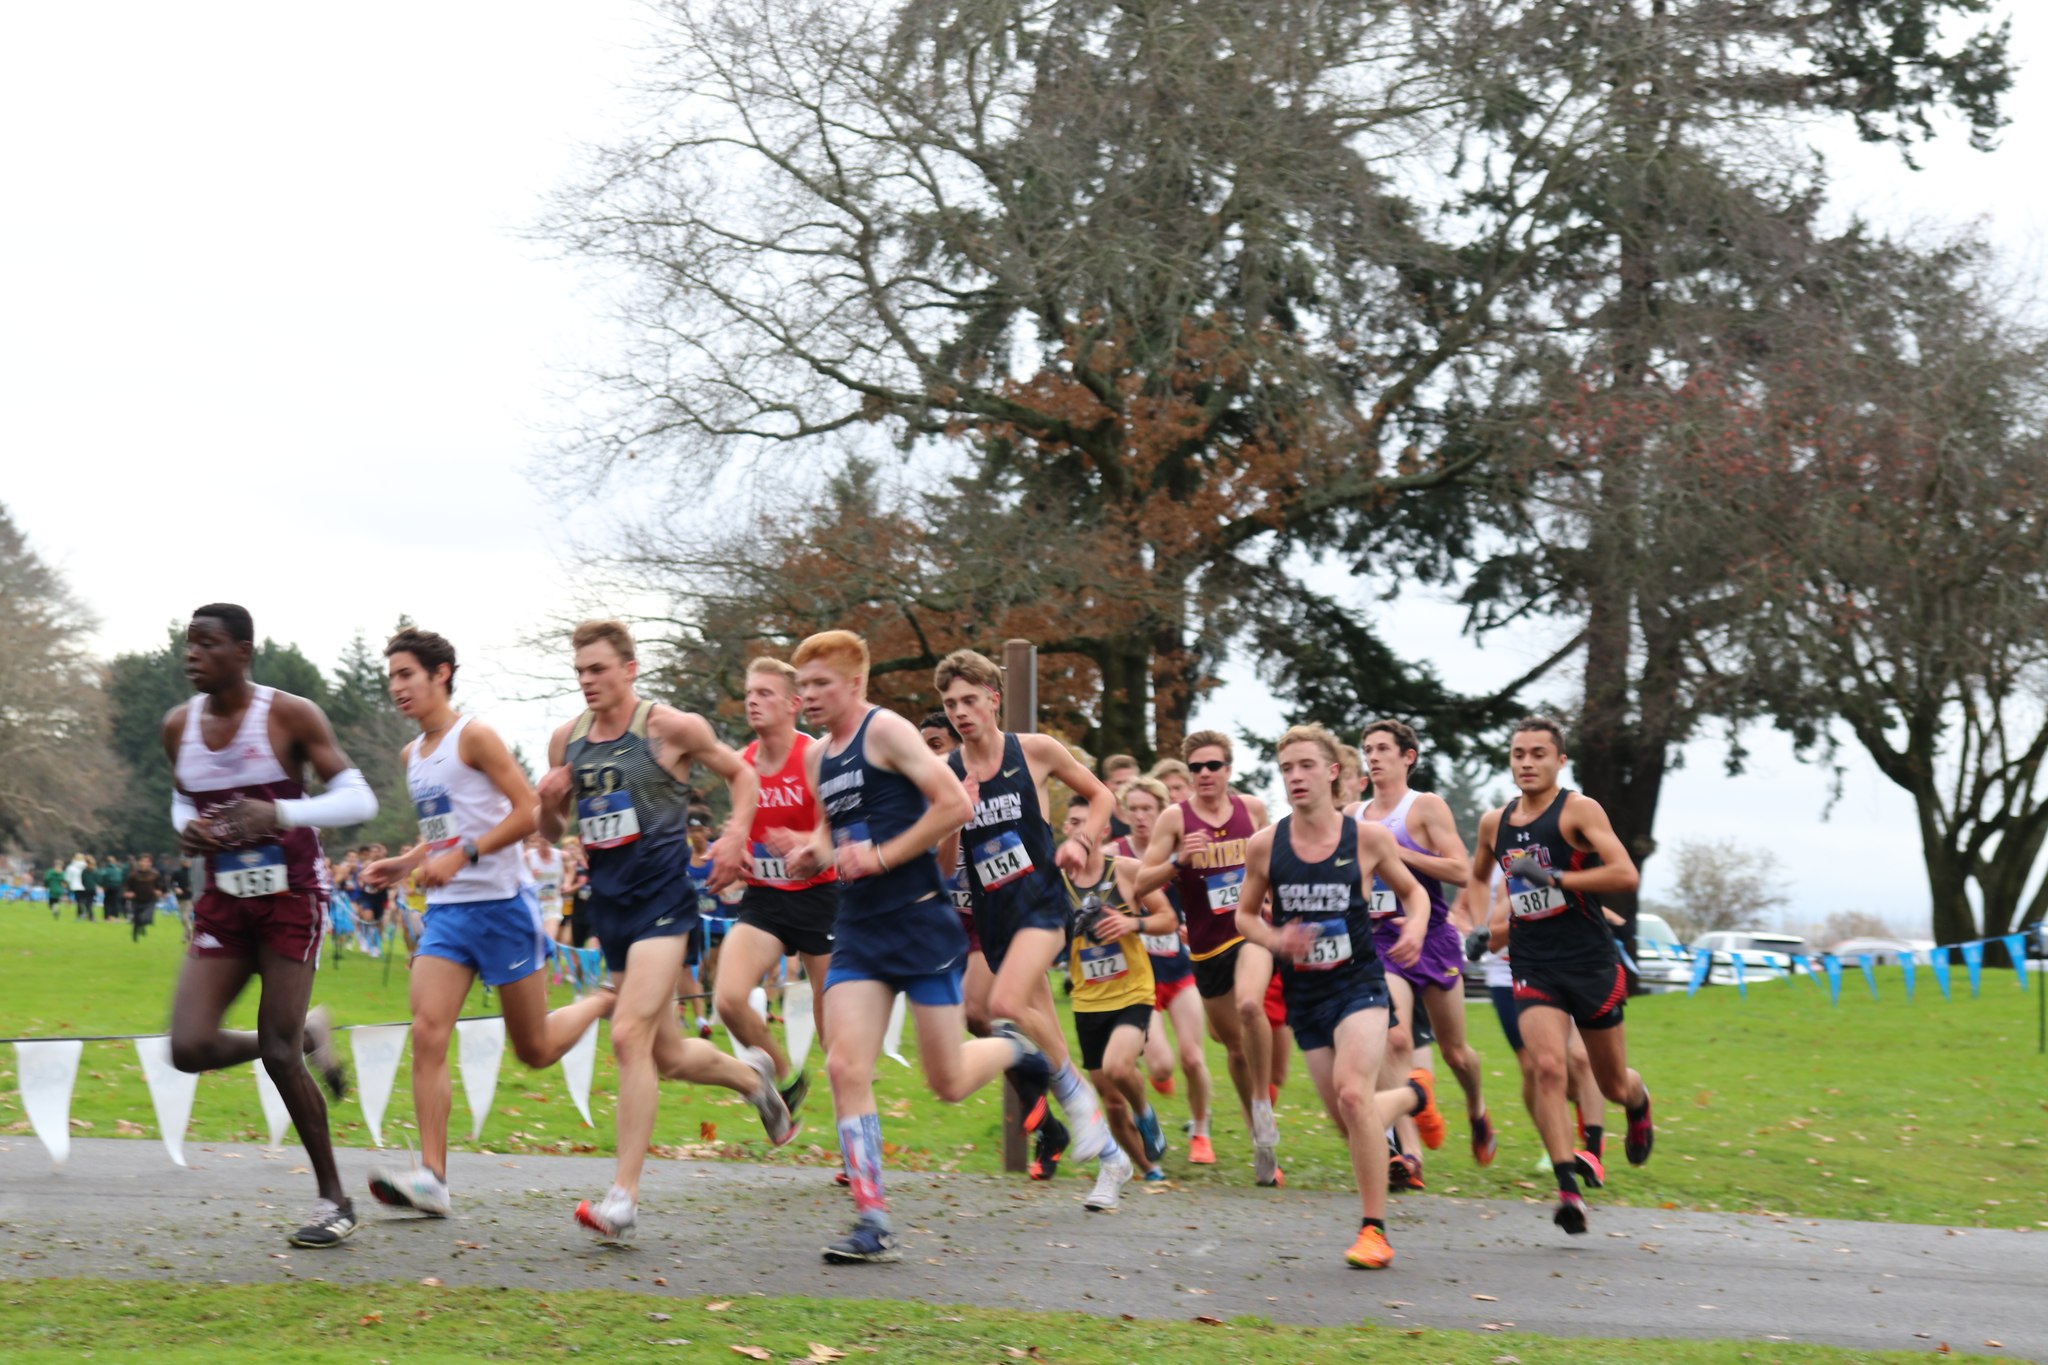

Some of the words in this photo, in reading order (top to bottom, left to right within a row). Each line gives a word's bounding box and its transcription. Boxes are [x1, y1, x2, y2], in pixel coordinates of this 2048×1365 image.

[756, 785, 804, 808] YAN
[761, 861, 792, 878] 11
[985, 852, 1020, 881] 154
[1219, 885, 1242, 906] 29
[1278, 884, 1351, 899] GOLDEN
[1519, 887, 1550, 914] 387
[1281, 897, 1350, 912] EAGLES
[1089, 958, 1118, 978] 172
